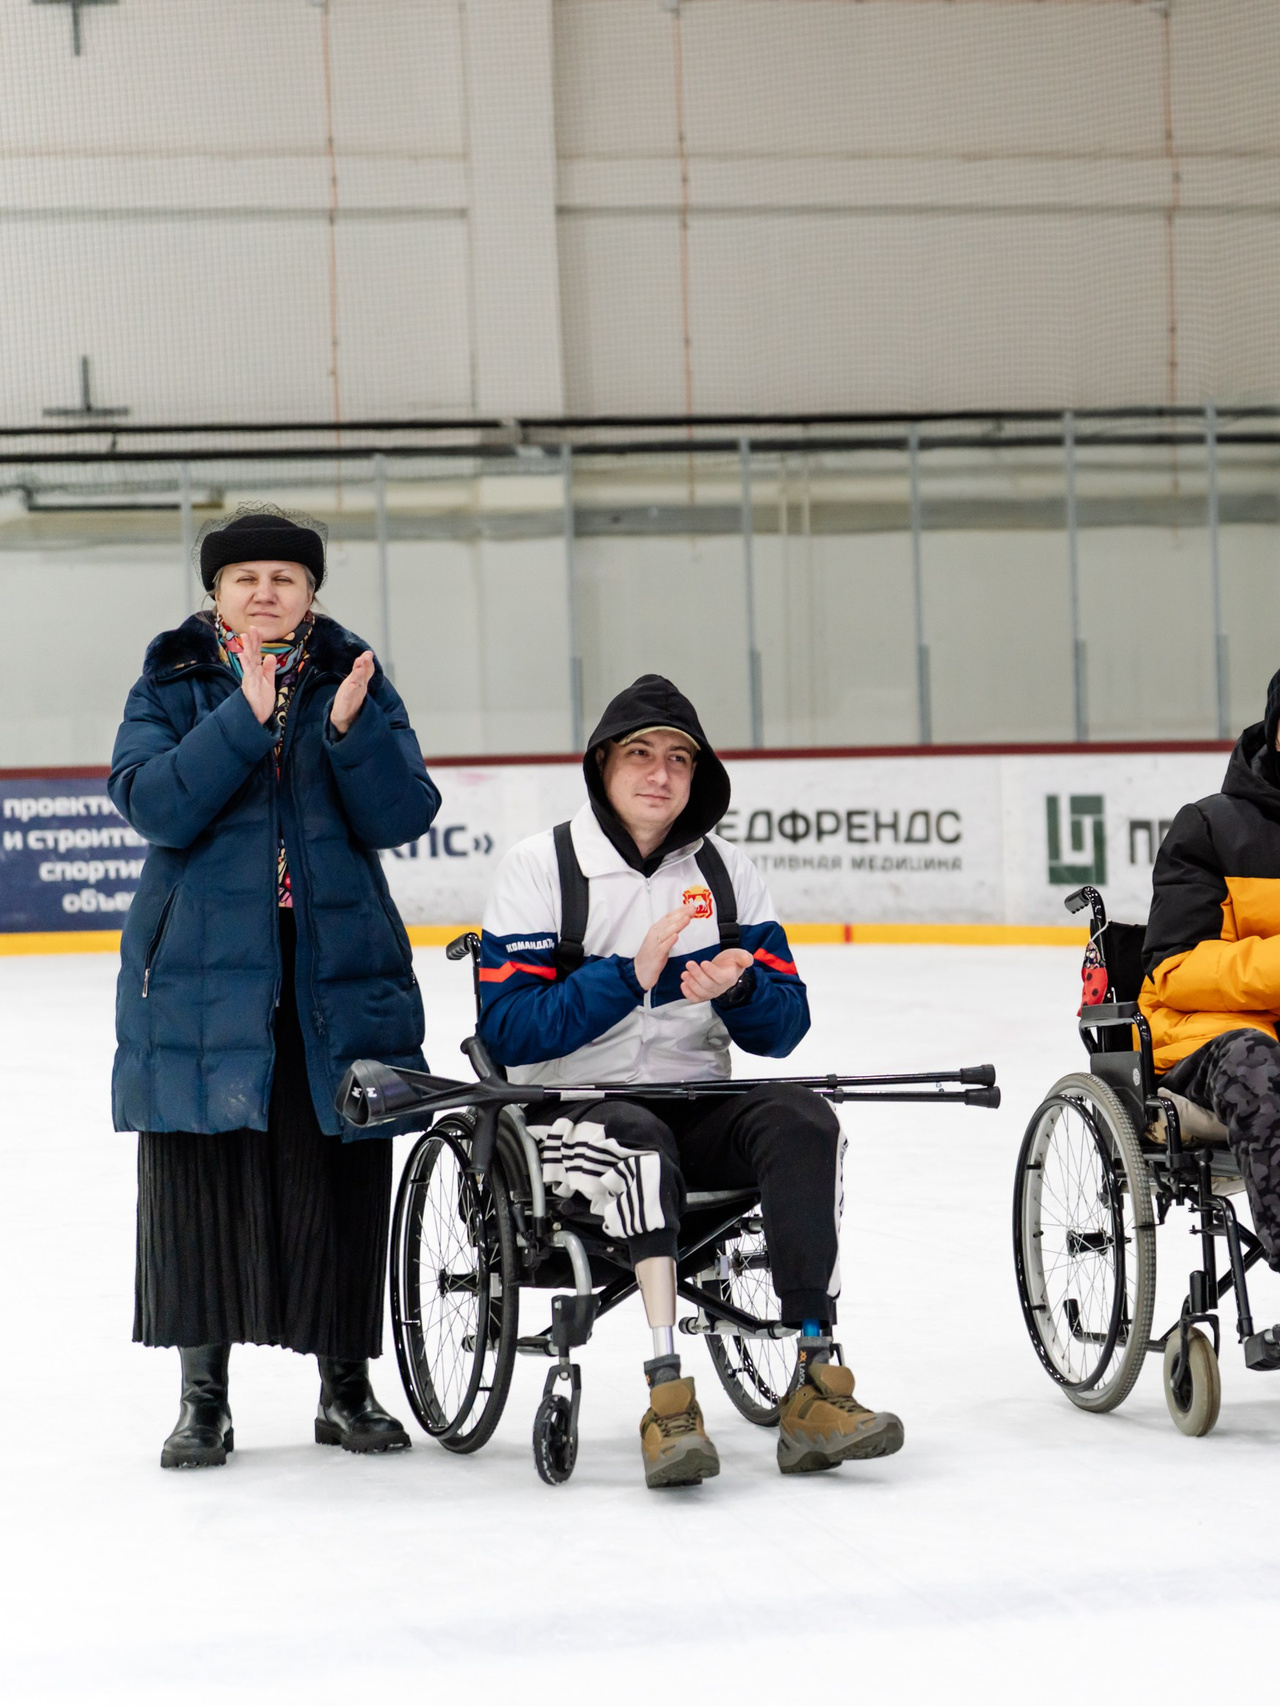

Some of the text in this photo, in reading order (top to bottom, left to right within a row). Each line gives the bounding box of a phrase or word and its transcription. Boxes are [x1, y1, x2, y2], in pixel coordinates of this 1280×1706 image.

[2, 829, 24, 852] и
[851, 854, 963, 872] МЕДИЦИНА
[62, 887, 135, 914] объе
